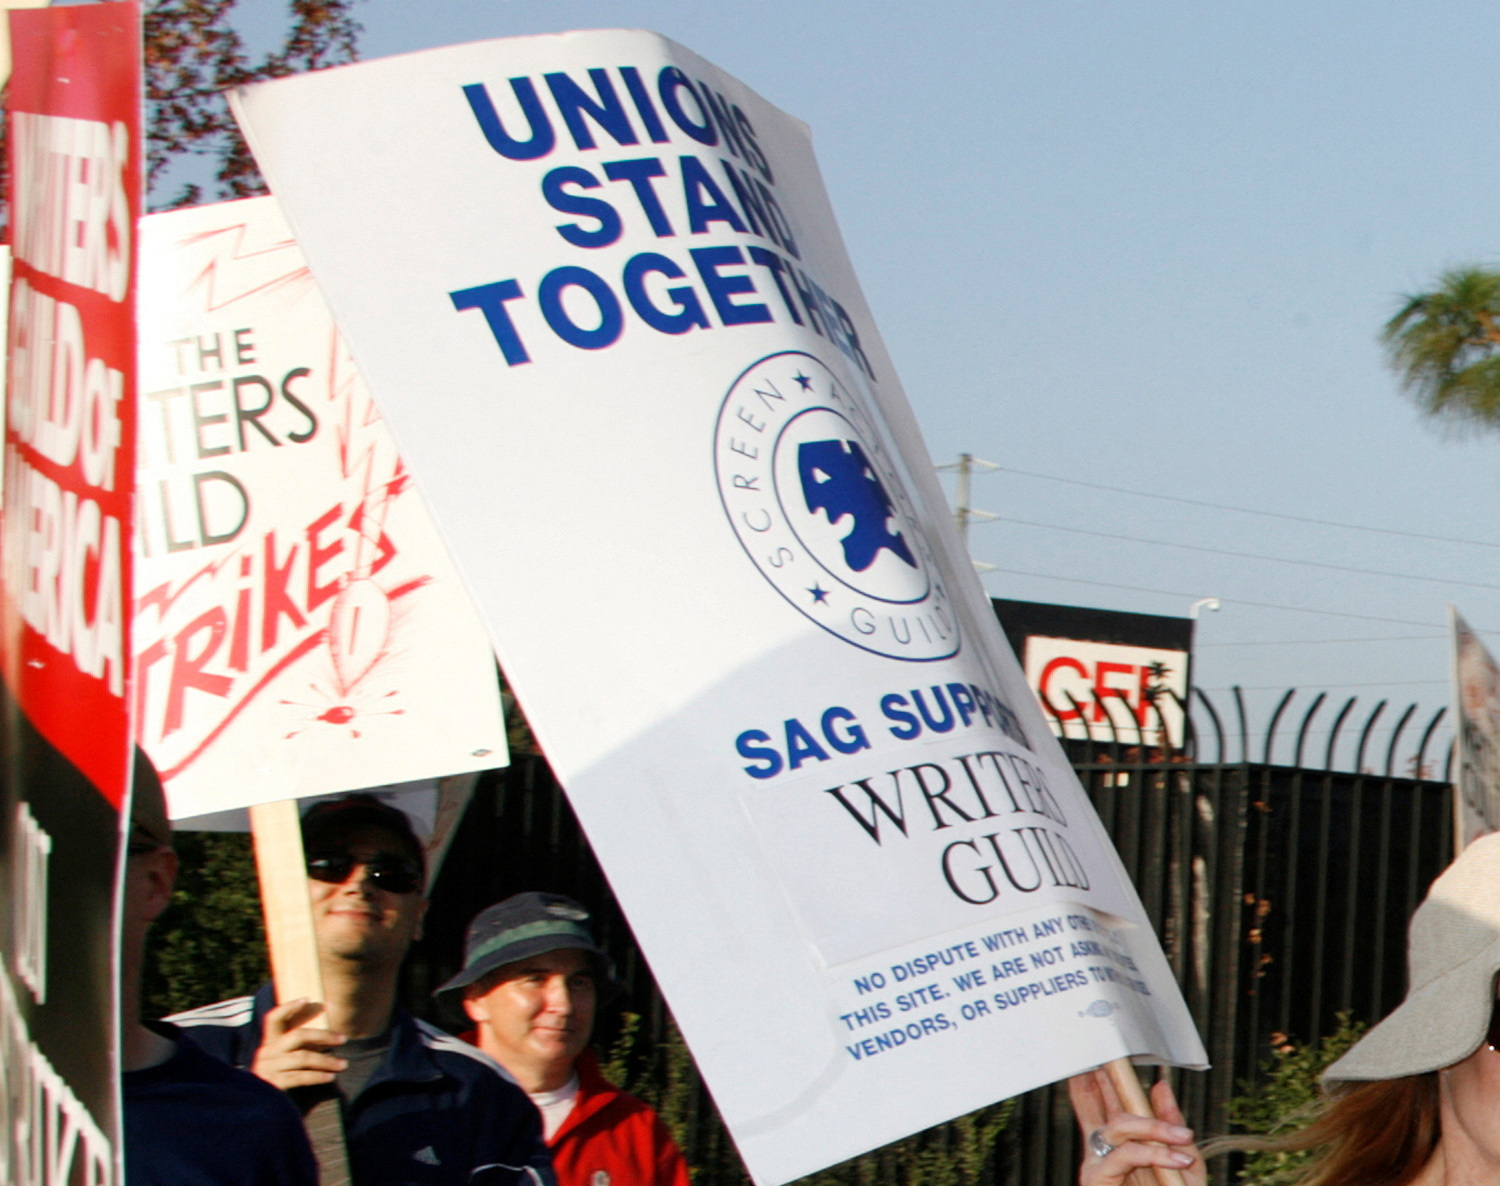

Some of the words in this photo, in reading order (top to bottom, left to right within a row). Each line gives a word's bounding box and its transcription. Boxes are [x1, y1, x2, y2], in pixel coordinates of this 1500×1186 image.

[461, 66, 776, 187] UNIONS
[541, 155, 801, 262] STAND
[163, 327, 257, 375] THE
[449, 245, 877, 383] TOGETHER
[81, 357, 125, 493] OF
[143, 367, 318, 467] TERS
[137, 470, 252, 559] ILD
[730, 378, 794, 569] SCREEN
[734, 707, 871, 780] SAG
[941, 826, 1091, 905] GUILD
[840, 1002, 891, 1032] THIS
[899, 983, 951, 1013] SITE.
[953, 969, 987, 993] WE
[992, 956, 1029, 981] ARE
[1033, 946, 1065, 969] NOT
[853, 972, 886, 996] NO
[891, 941, 980, 983] DISPUTE
[981, 926, 1031, 953] WITH
[1034, 916, 1064, 940] ANY
[847, 1011, 959, 1061] VENDORS,
[961, 999, 992, 1021] OR
[995, 969, 1089, 1011] SUPPLIERS
